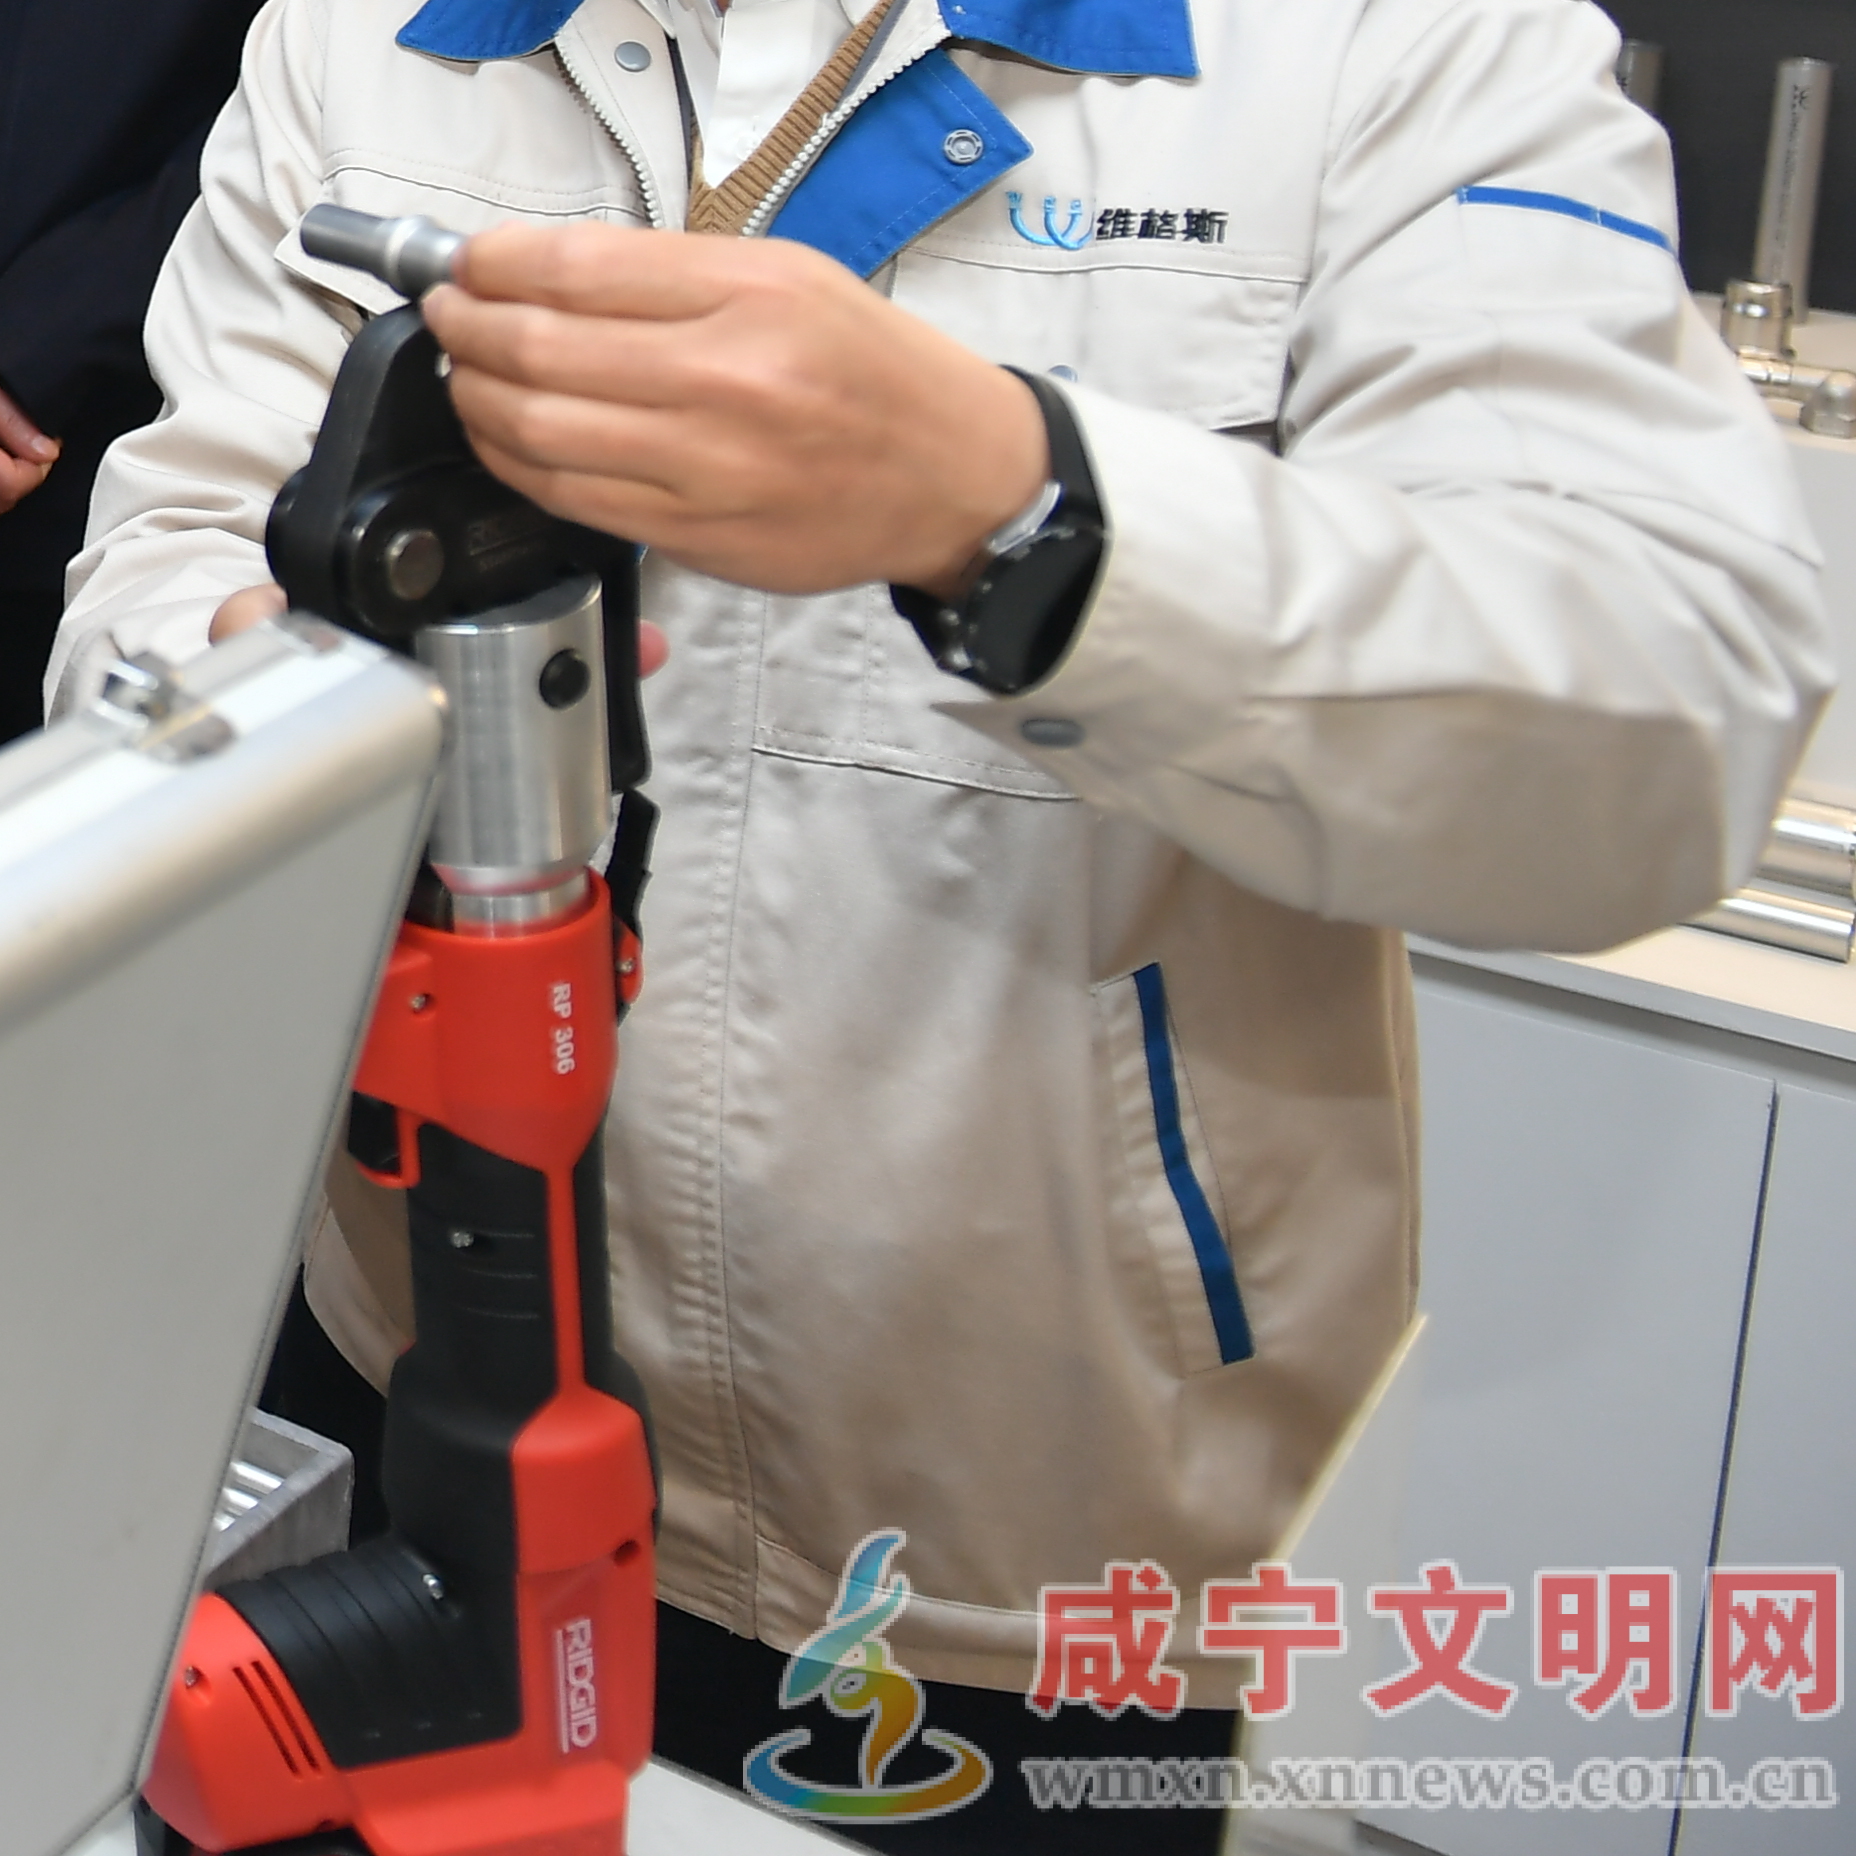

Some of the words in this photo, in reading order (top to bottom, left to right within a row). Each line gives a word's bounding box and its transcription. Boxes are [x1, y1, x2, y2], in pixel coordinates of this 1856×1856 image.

[1095, 207, 1230, 244] 维格斯
[552, 981, 572, 1019] RP
[554, 1025, 576, 1075] 306
[565, 1618, 598, 1749] RIDGID
